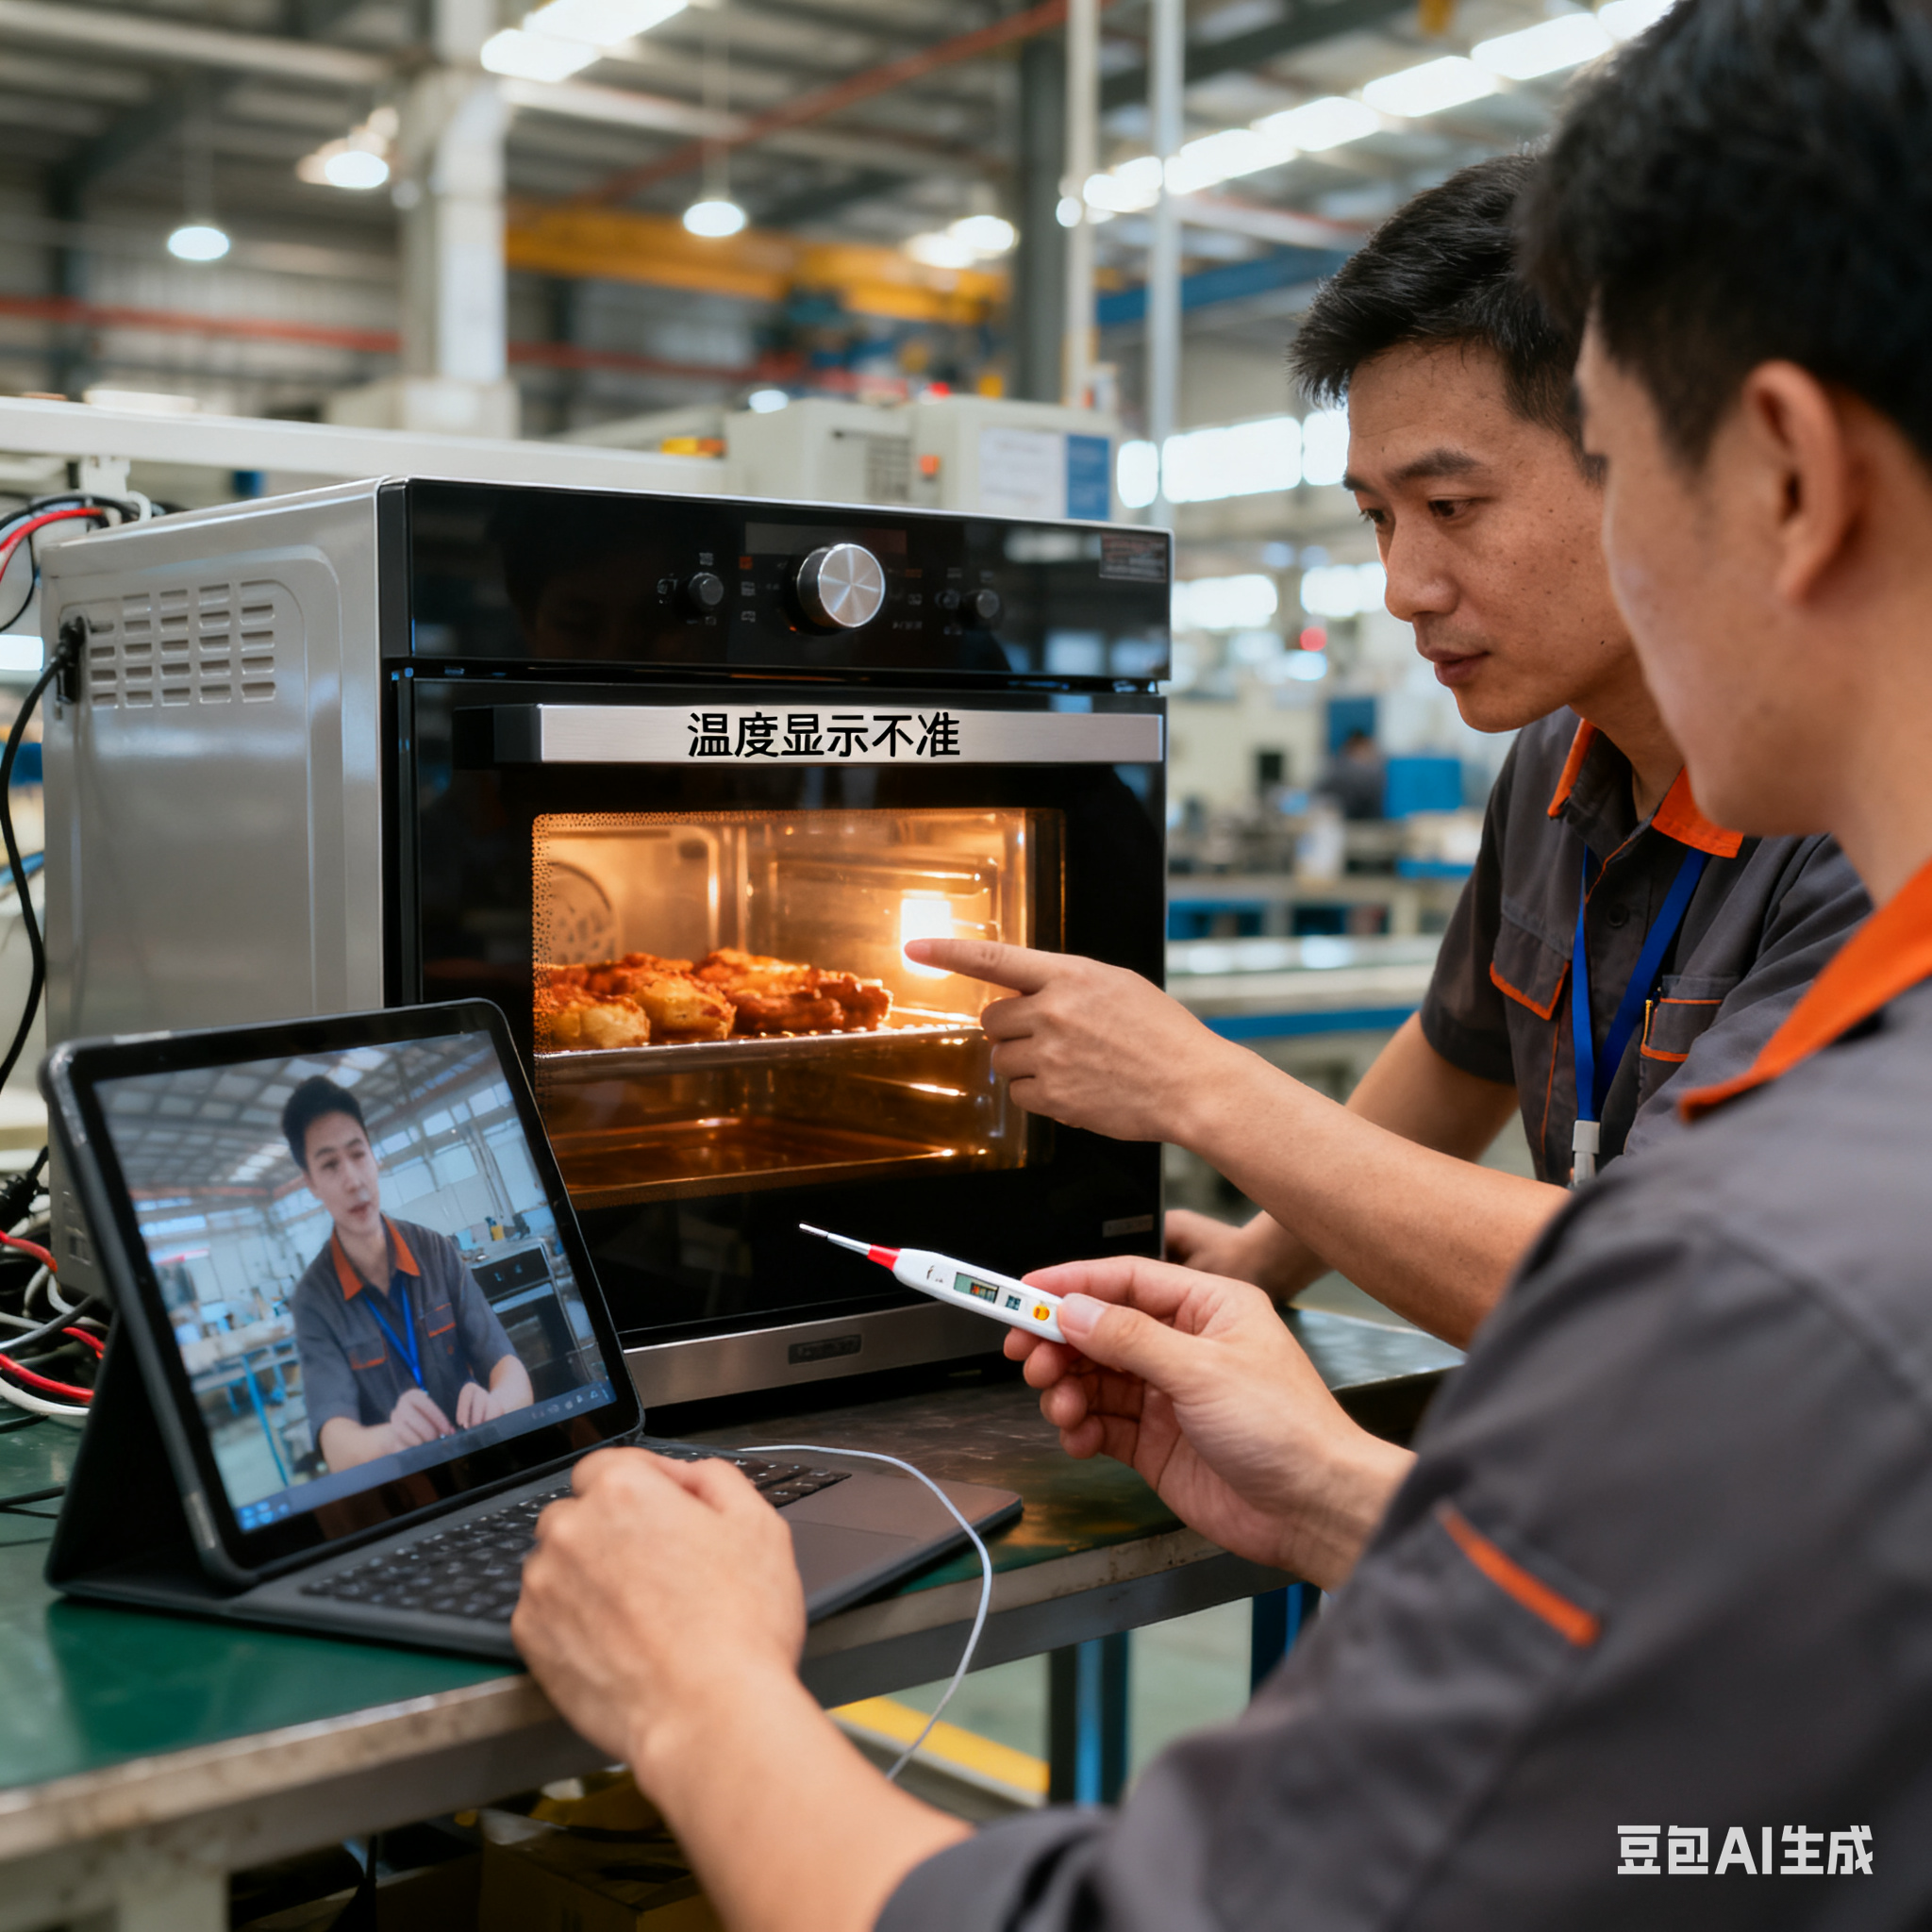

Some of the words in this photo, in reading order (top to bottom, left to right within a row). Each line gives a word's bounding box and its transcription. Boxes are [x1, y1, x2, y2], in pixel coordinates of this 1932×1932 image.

[687, 711, 960, 758] 温度显示不准
